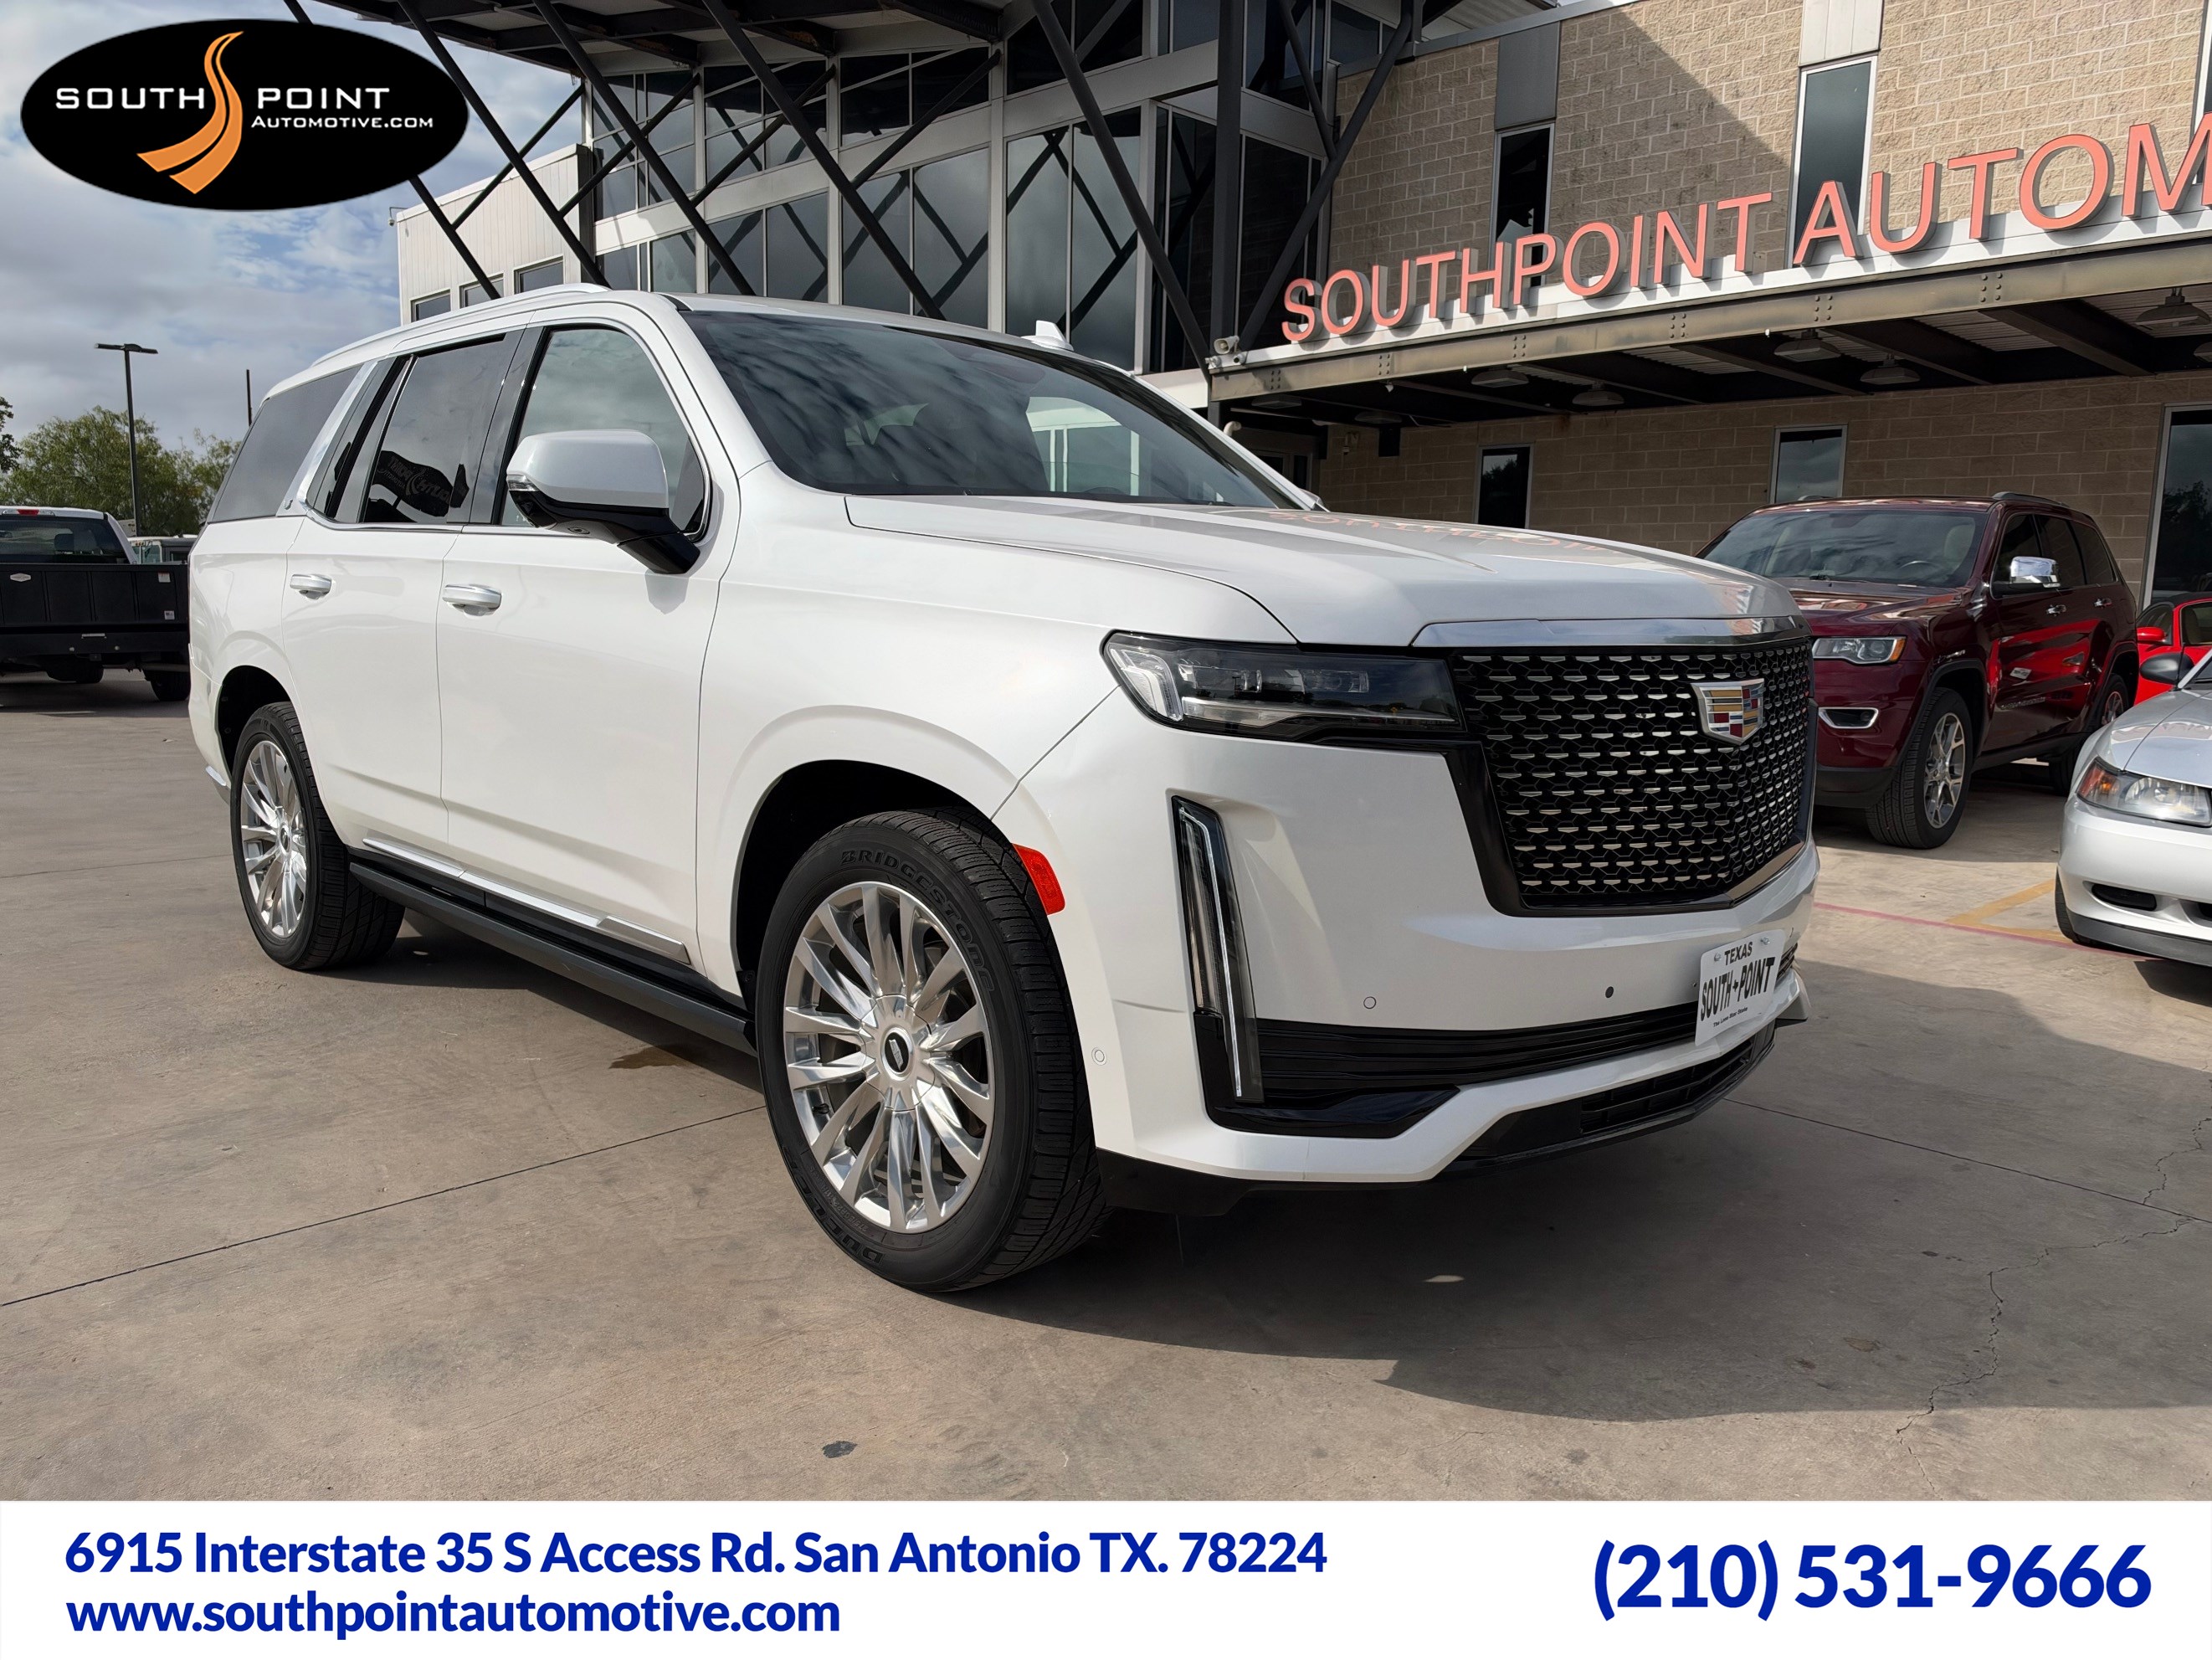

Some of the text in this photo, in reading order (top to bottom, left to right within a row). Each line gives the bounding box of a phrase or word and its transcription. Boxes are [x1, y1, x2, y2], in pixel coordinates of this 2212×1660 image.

[1281, 192, 1774, 343] SOUTHPOINT
[839, 848, 995, 992] BRIDGESTONE
[1724, 941, 1753, 966] TEXAS
[1700, 956, 1776, 1022] SOUTH POINT
[1737, 1006, 1748, 1015] State
